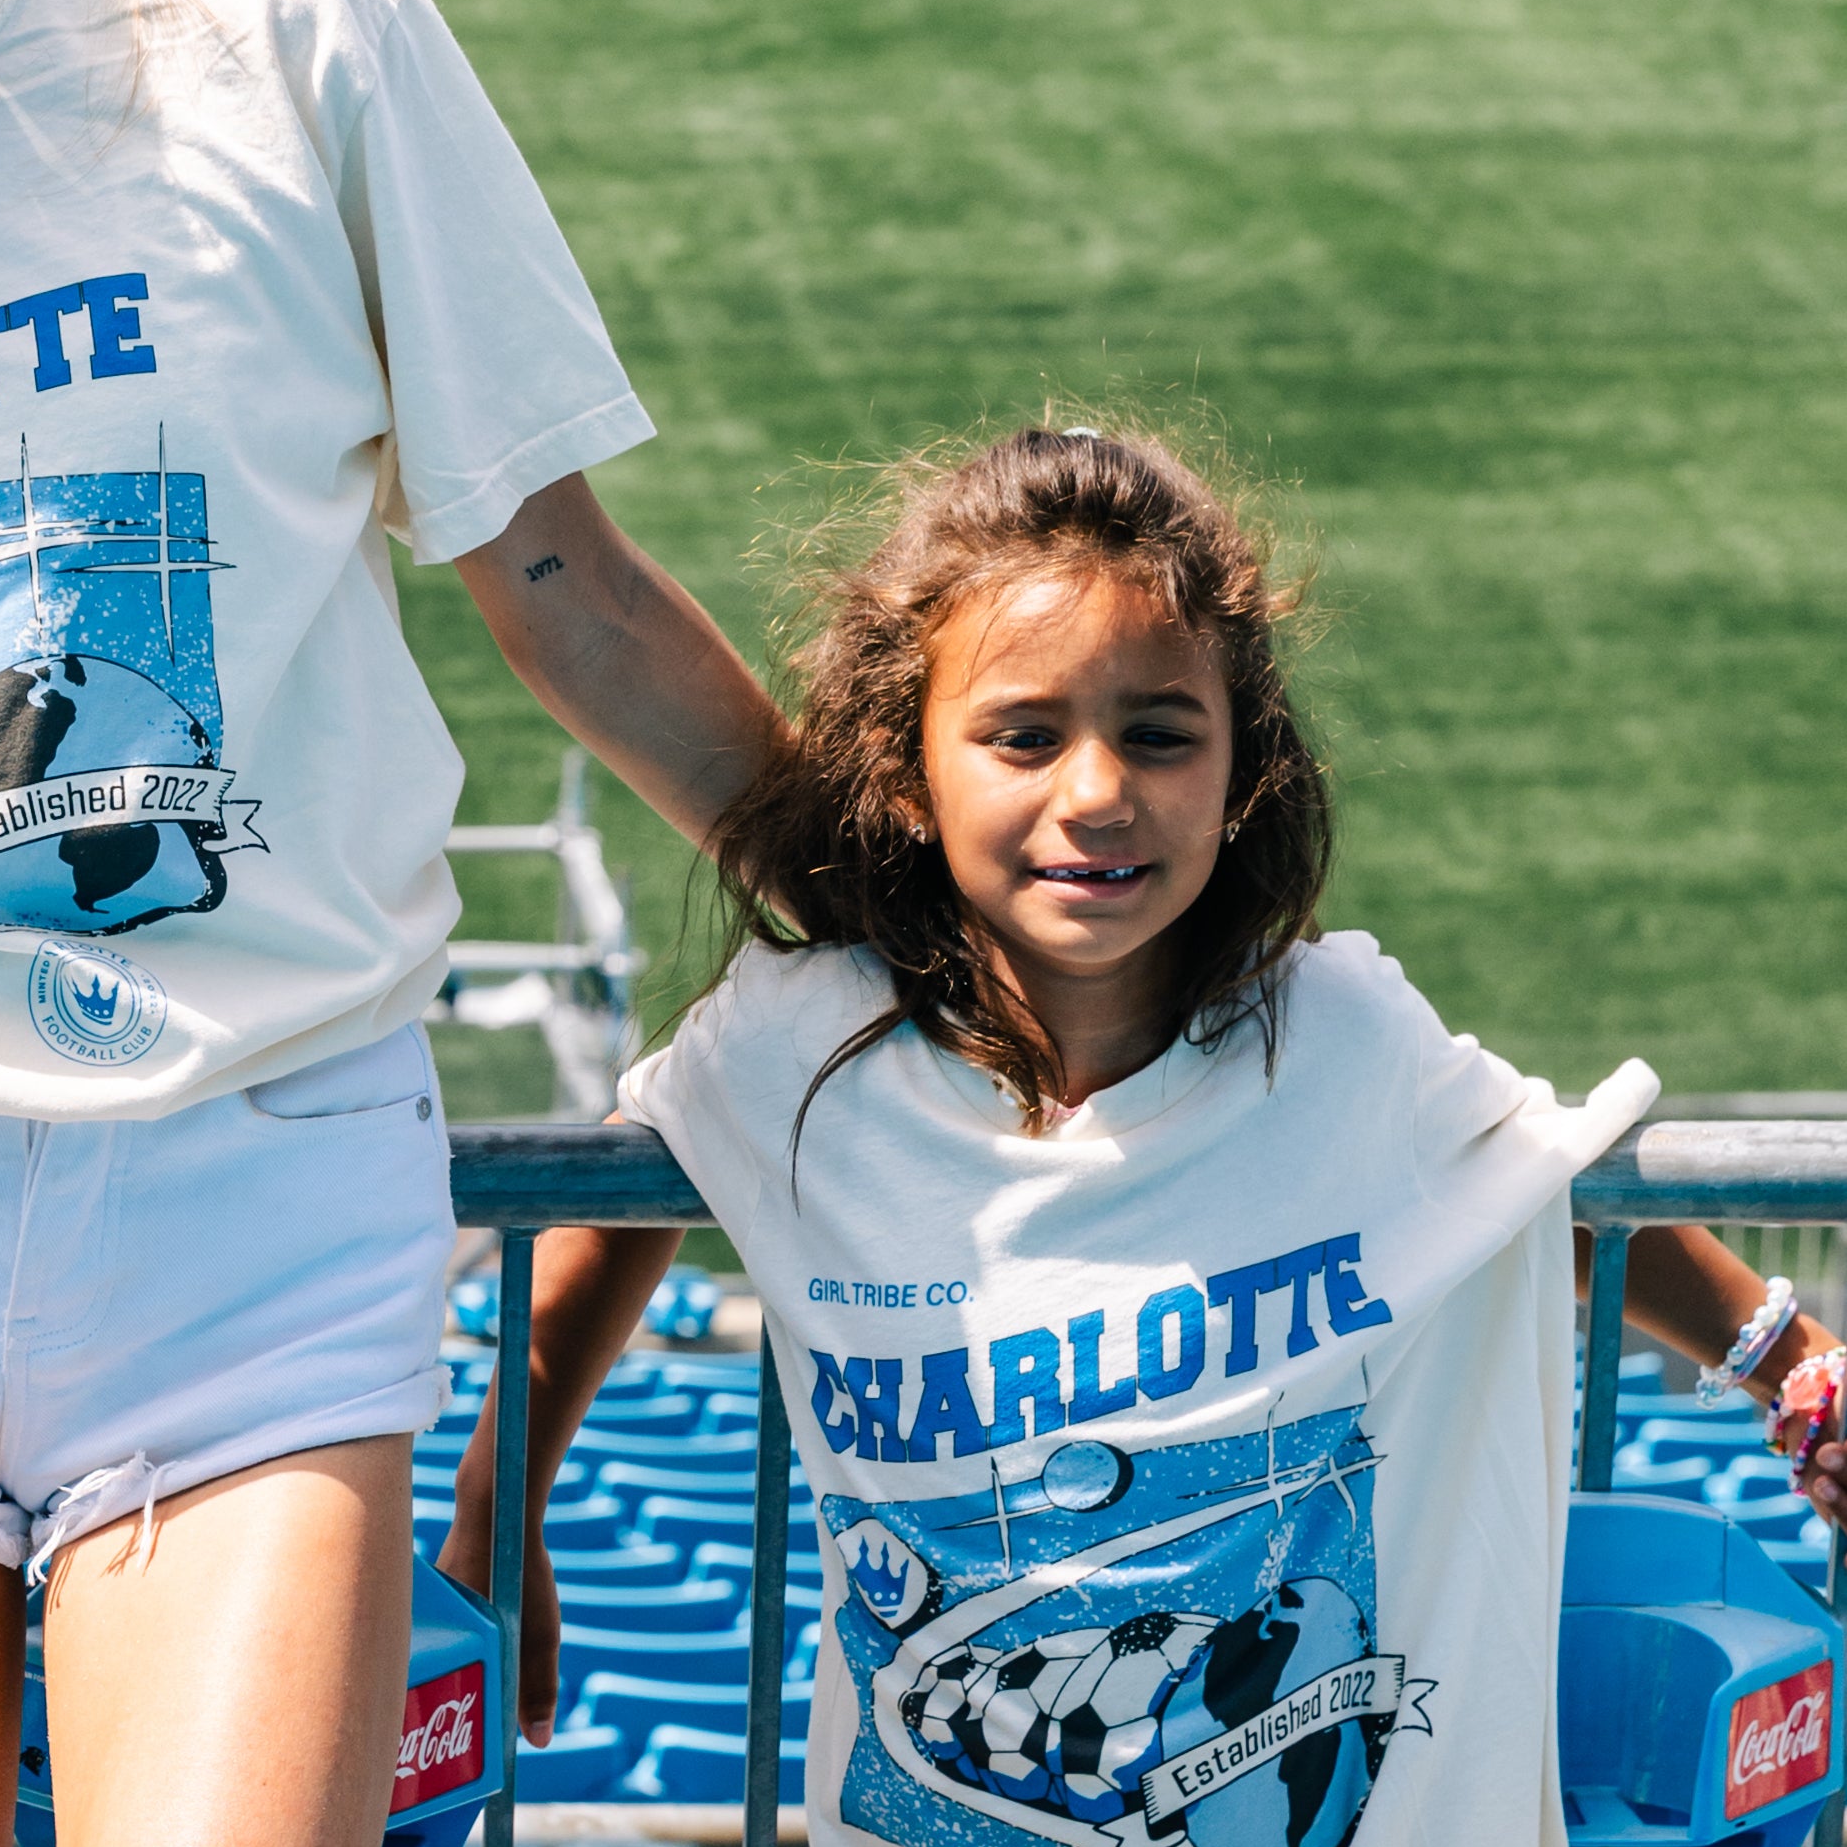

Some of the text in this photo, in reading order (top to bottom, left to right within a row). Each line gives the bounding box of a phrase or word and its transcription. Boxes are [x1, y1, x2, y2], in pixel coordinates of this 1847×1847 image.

[525, 555, 564, 582] 1971
[141, 774, 209, 813] 2022
[38, 959, 51, 1004] MINTED
[42, 1015, 152, 1061] FOOTBALL CLUB
[808, 1277, 974, 1308] GIRL TRIBE CO.
[809, 1232, 1393, 1464] CHARLOTTE
[1171, 1670, 1376, 1798] Established 2022
[1733, 1690, 1827, 1785] Coca-Cola
